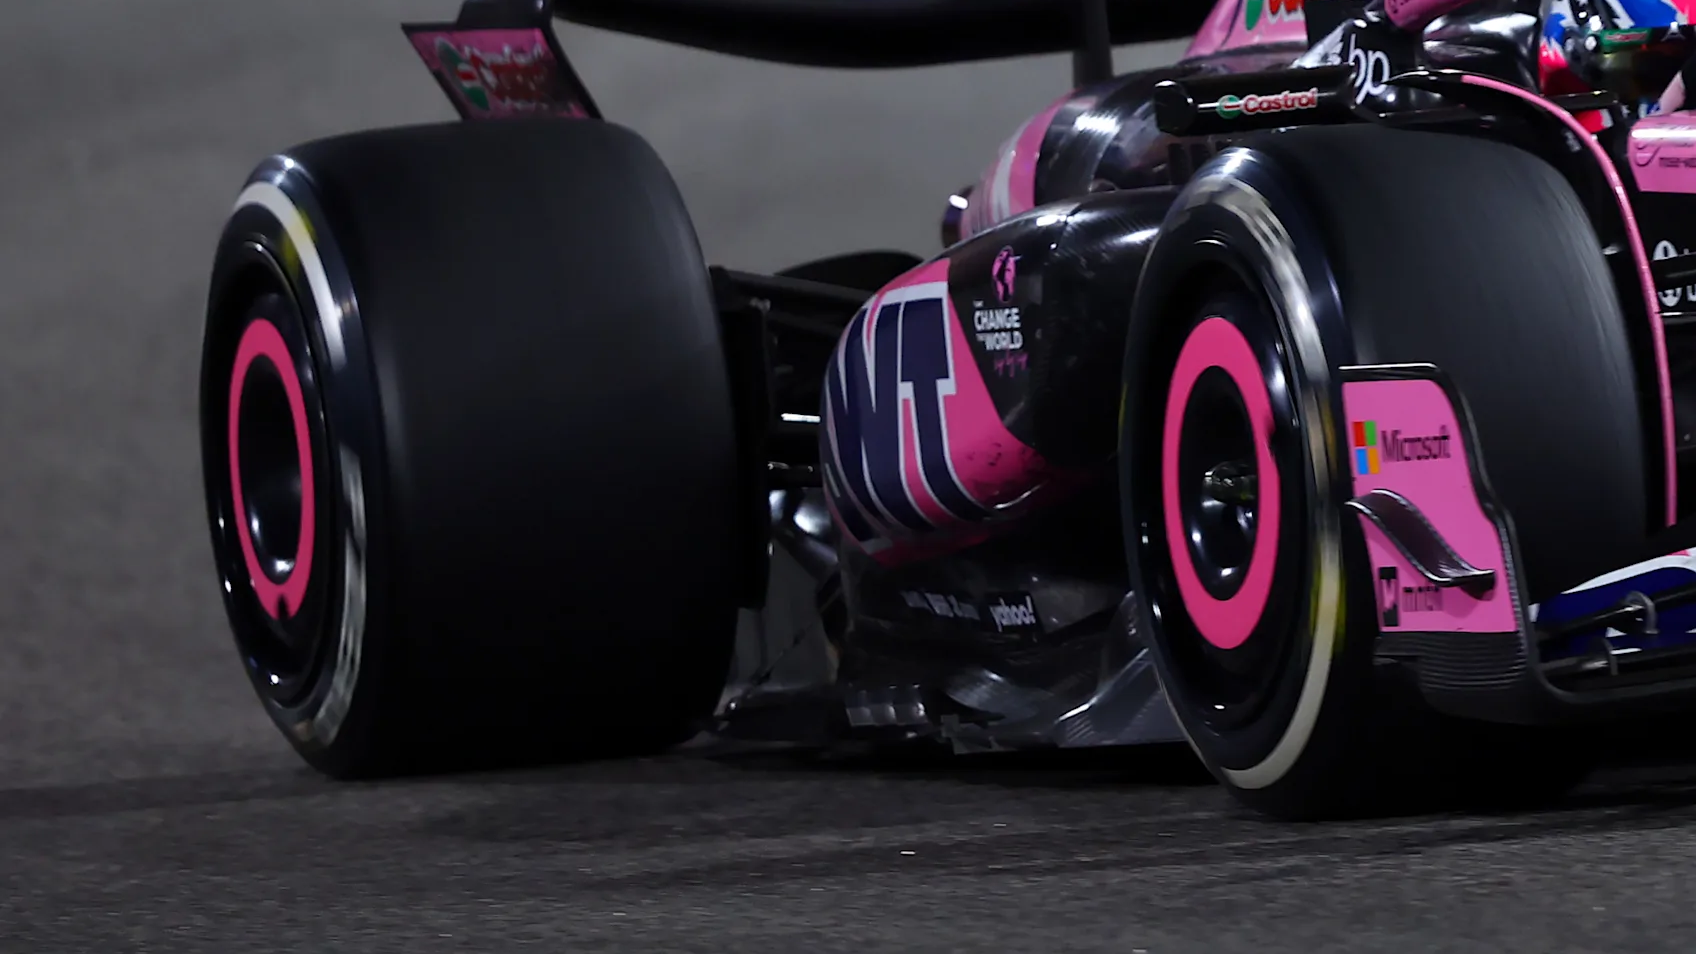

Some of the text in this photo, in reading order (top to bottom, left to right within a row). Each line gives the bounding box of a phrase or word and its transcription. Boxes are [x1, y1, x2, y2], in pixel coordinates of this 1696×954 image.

[1242, 87, 1319, 115] Castrol
[973, 307, 1021, 331] CHANGE
[984, 330, 1025, 351] WORLD
[1381, 424, 1452, 464] Microsoft
